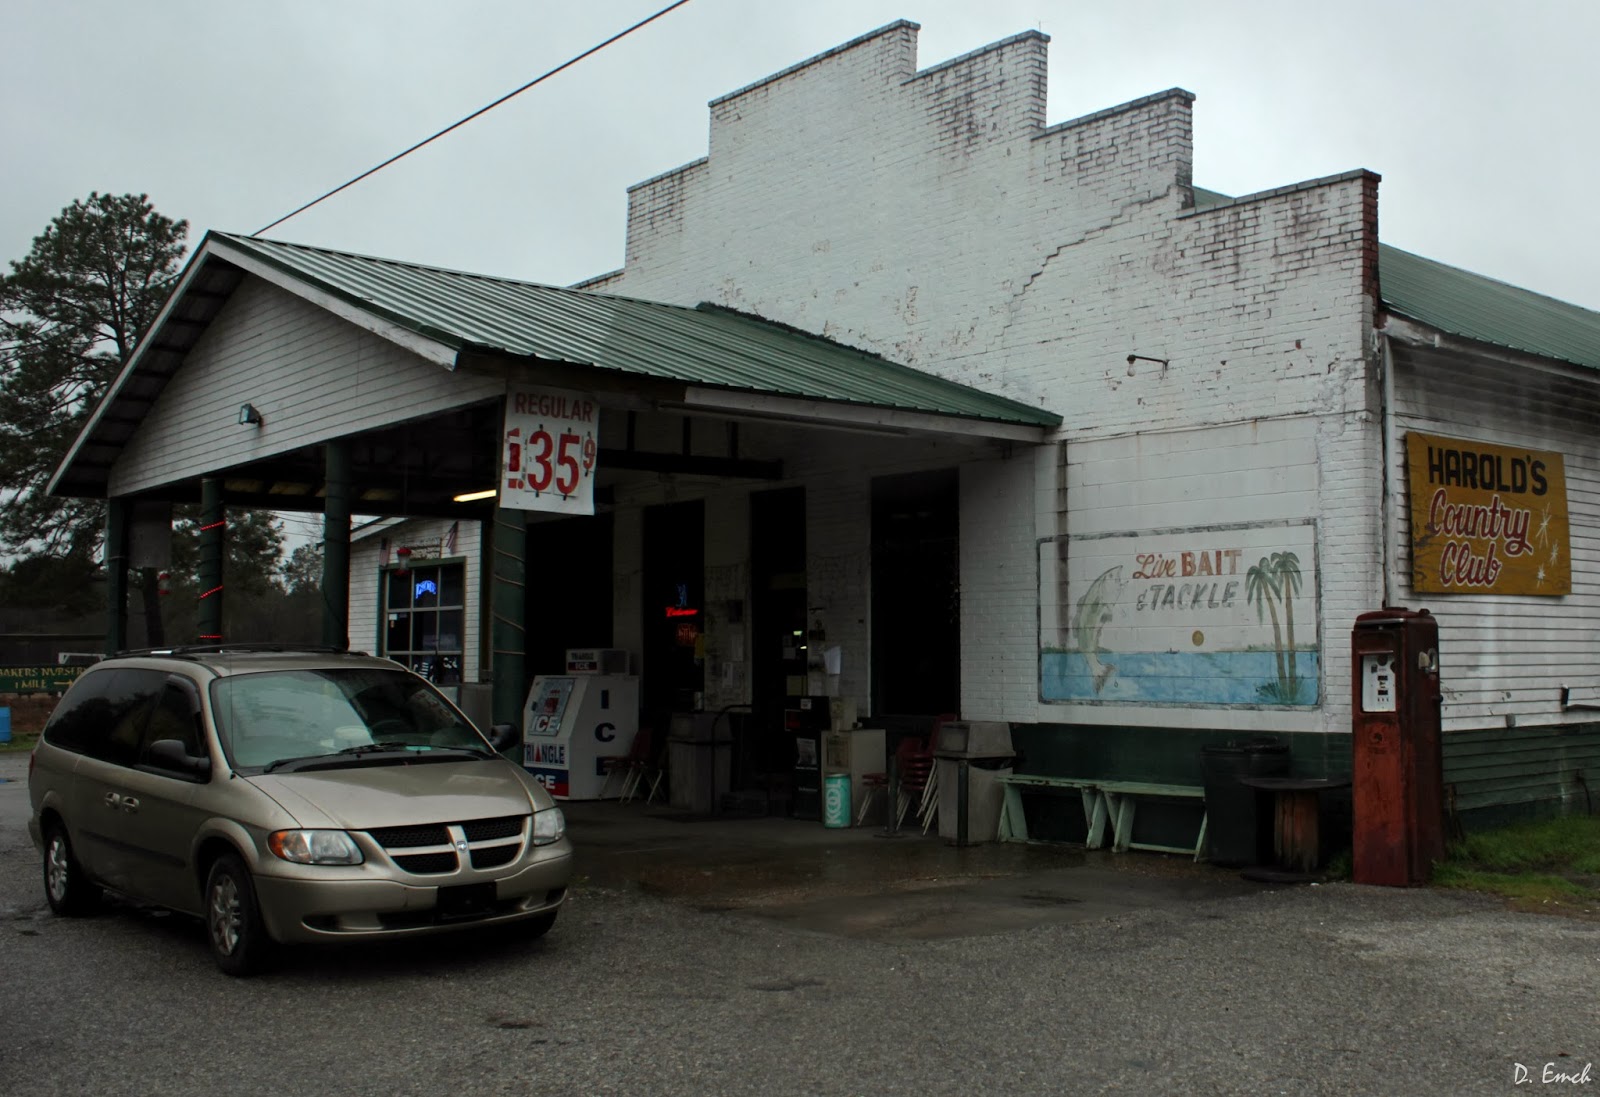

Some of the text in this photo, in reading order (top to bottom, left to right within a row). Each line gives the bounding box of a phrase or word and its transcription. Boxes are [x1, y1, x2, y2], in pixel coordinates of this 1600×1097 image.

[515, 393, 593, 422] REGULAR
[1428, 446, 1548, 496] HAROLD'S
[1429, 487, 1533, 557] Country
[1132, 550, 1242, 579] Live BAIT
[1439, 540, 1502, 587] Club
[21, 679, 47, 689] MILE
[531, 714, 559, 732] ICE
[523, 743, 565, 765] RIANGLE
[534, 773, 557, 790] CE
[825, 779, 842, 824] KOOL
